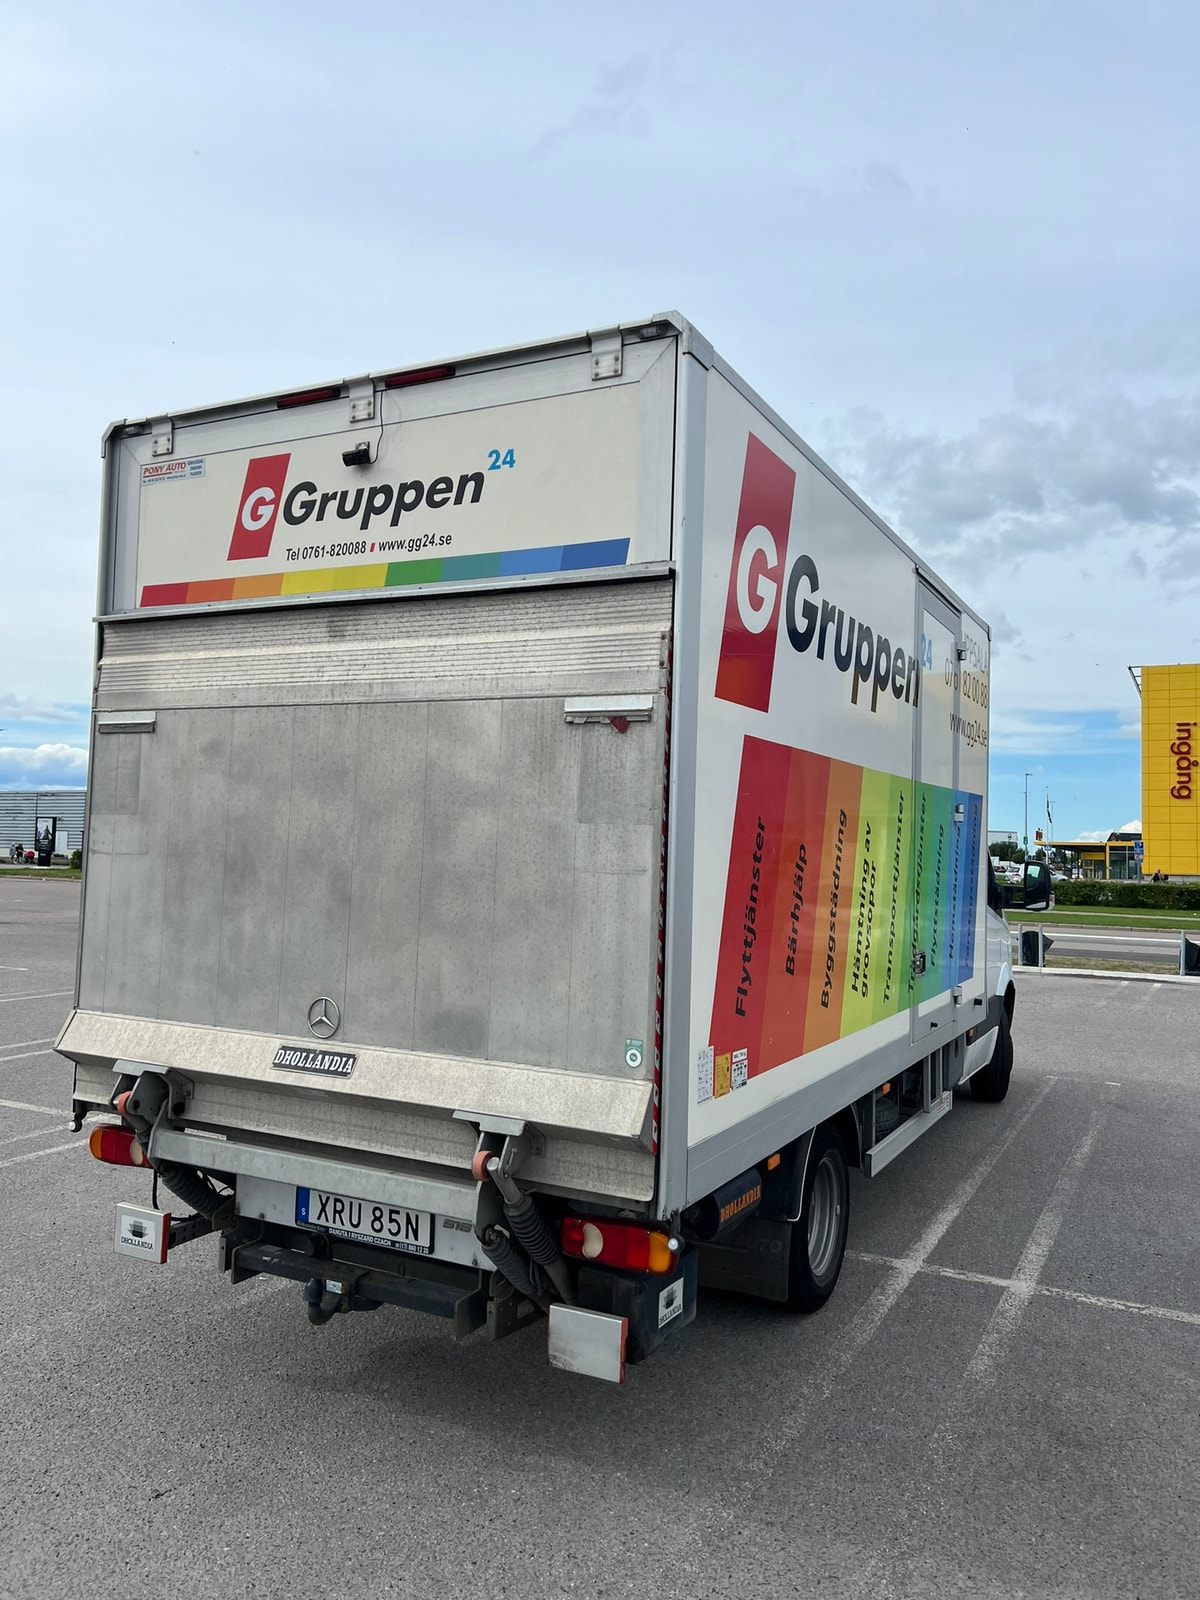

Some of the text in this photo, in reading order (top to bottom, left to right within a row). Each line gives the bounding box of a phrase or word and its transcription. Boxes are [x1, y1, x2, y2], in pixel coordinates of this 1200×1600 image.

[143, 465, 164, 475] PONY
[166, 461, 187, 472] AUTO
[283, 471, 485, 531] Gruppen
[487, 449, 516, 471] 24
[286, 533, 452, 561] Tel 0761-820088 www.gg24.se
[785, 554, 919, 713] Gruppen
[920, 632, 933, 671] 24
[1170, 722, 1199, 799] ingång
[735, 816, 766, 1017] Flyttjänster
[786, 843, 807, 976] Bärhjälp
[821, 808, 847, 1008] Byggstädning
[851, 821, 872, 993] Hämtning av
[861, 861, 877, 998] grovsopor
[883, 790, 905, 1004] Transporttjänster
[931, 824, 944, 967] Flyttstädning
[273, 1049, 354, 1073] DHOLLANDIA
[121, 1236, 154, 1250] DHOLLANDIA
[301, 1194, 419, 1242] S XRU 85N
[374, 1237, 392, 1247] CZACH
[720, 1185, 761, 1223] DHOLLANDIA
[659, 1303, 682, 1323] DHOLLANDIA
